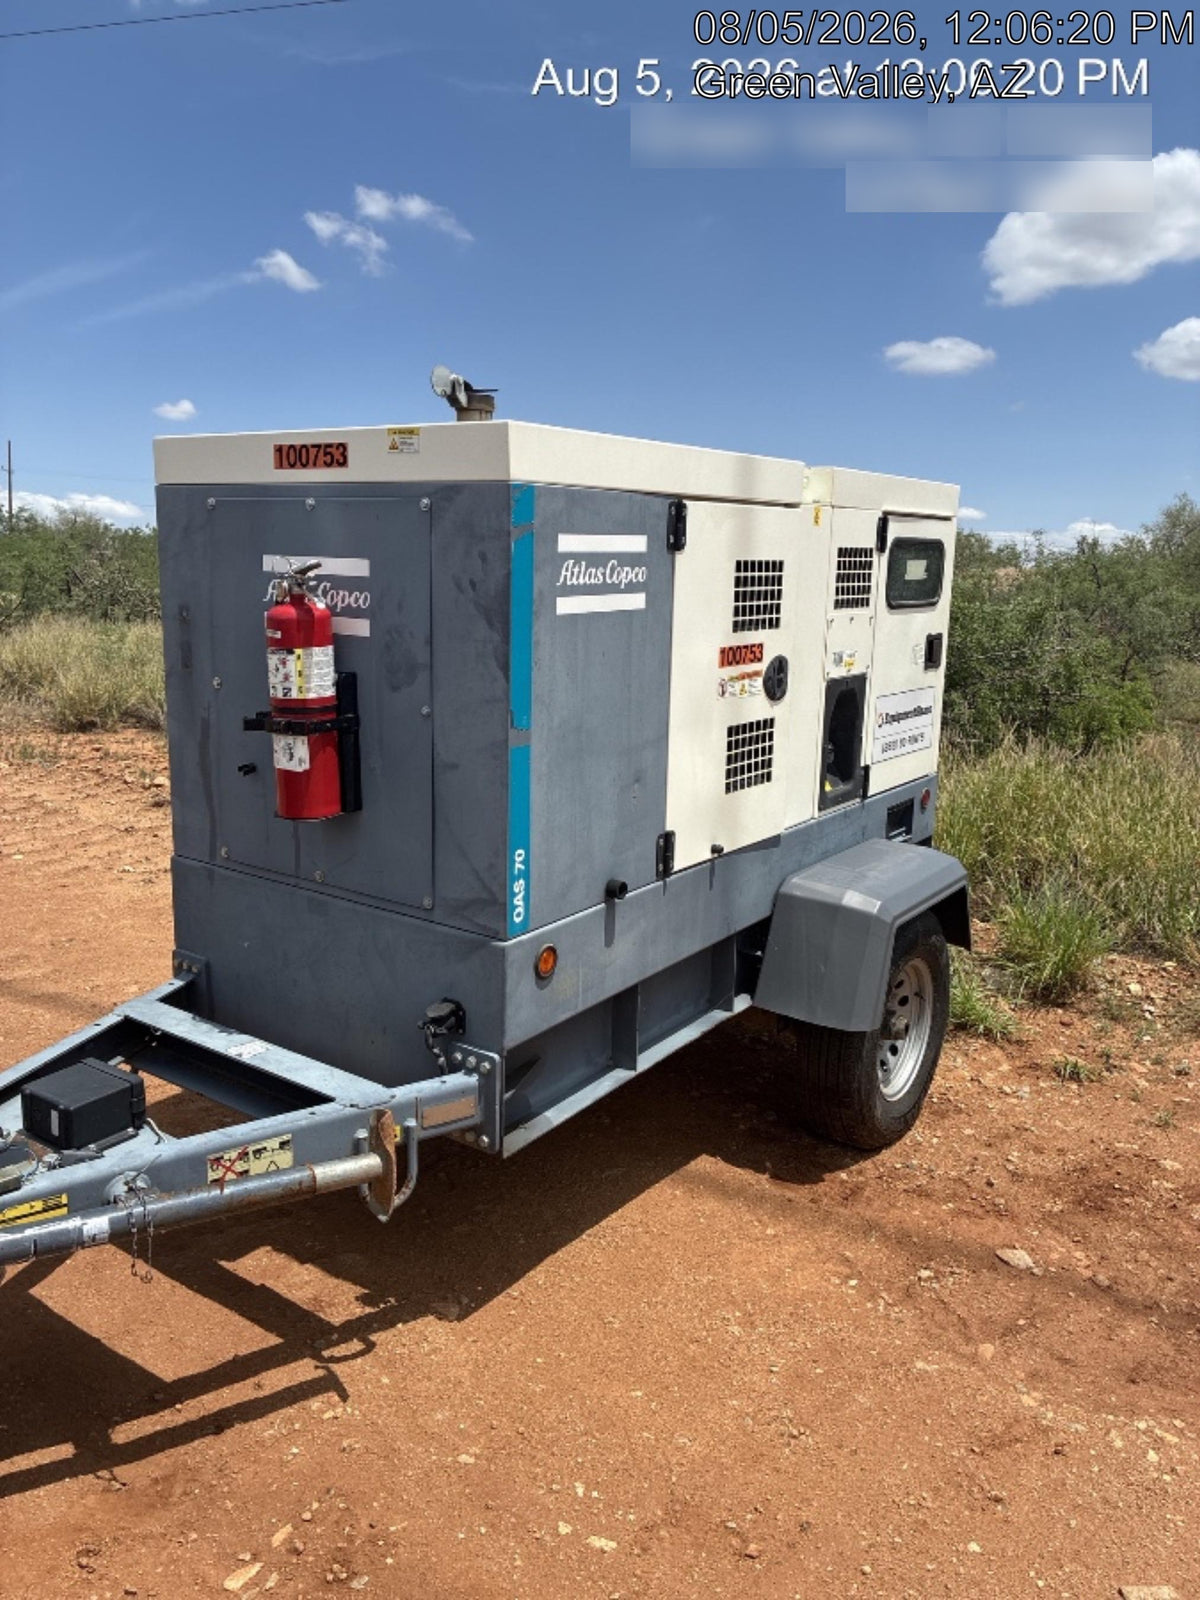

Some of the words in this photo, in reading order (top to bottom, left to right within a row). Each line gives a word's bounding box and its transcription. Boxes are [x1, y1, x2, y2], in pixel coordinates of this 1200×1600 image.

[274, 442, 348, 469] 100753
[556, 560, 605, 586] Atlas
[605, 560, 647, 589] Copco
[316, 581, 371, 612] Copco
[719, 643, 763, 667] 100753
[514, 848, 525, 875] 70
[513, 878, 525, 923] OAS
